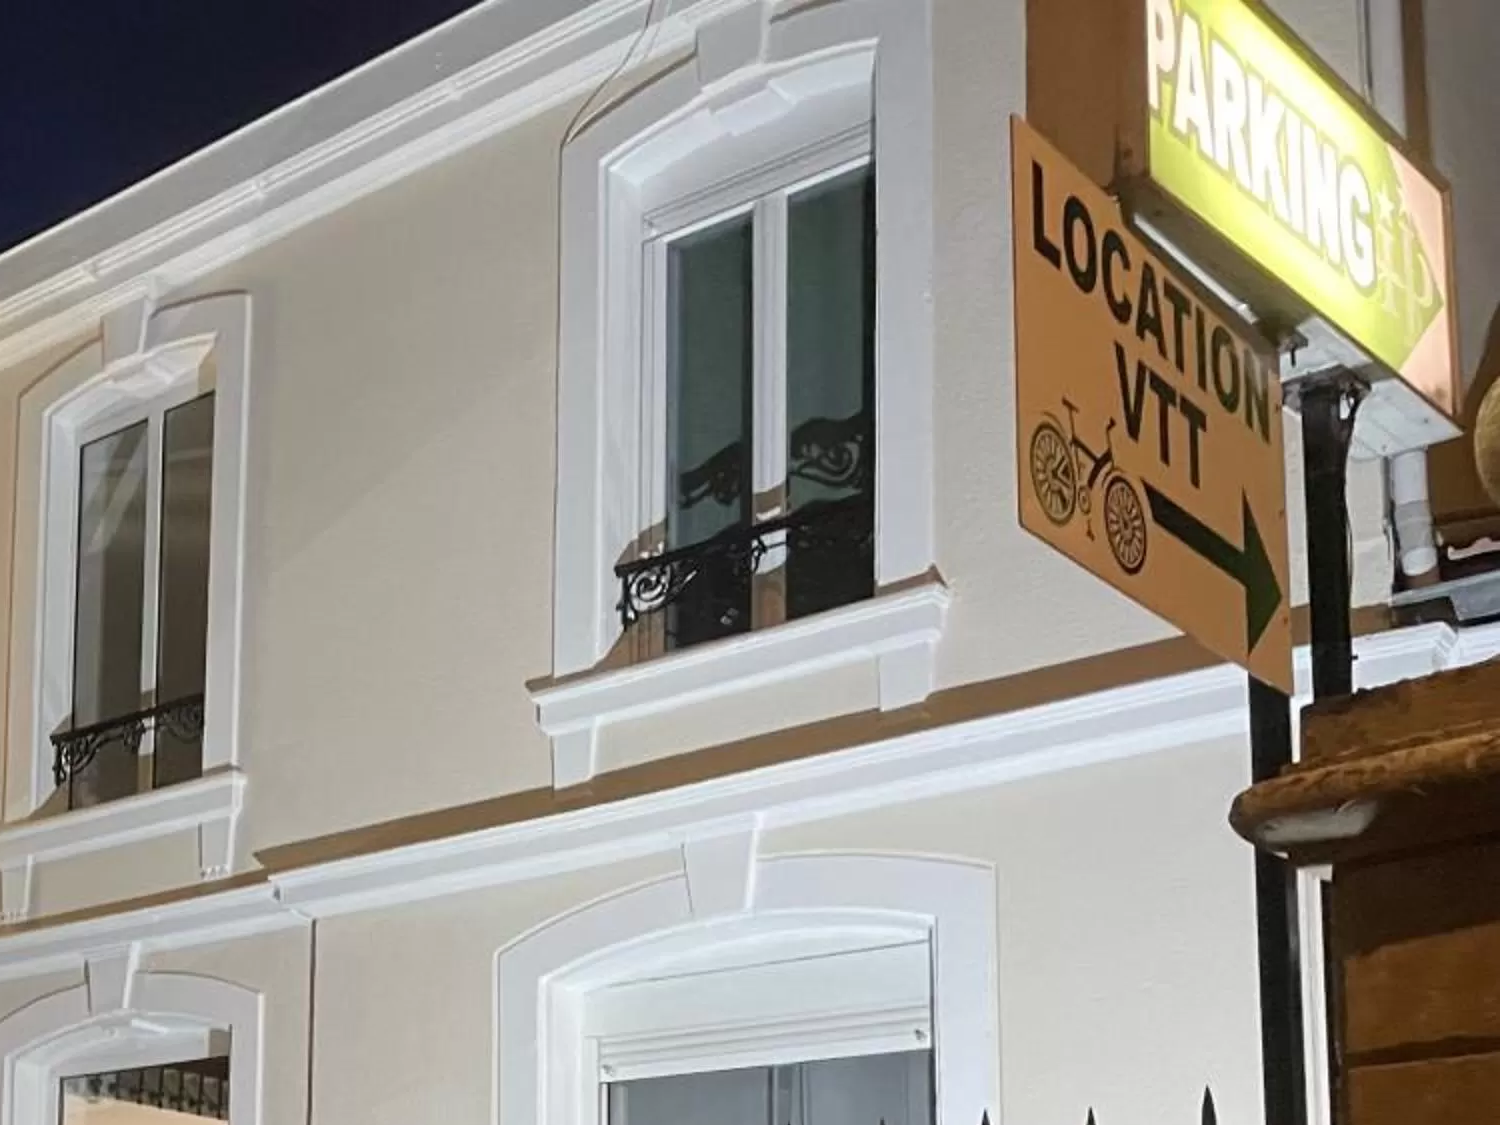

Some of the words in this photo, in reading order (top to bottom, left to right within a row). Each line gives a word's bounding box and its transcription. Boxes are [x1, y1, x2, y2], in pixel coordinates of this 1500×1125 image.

[1146, 0, 1376, 290] PARKING
[1031, 160, 1272, 444] LOCATION
[1114, 340, 1208, 488] VTT
